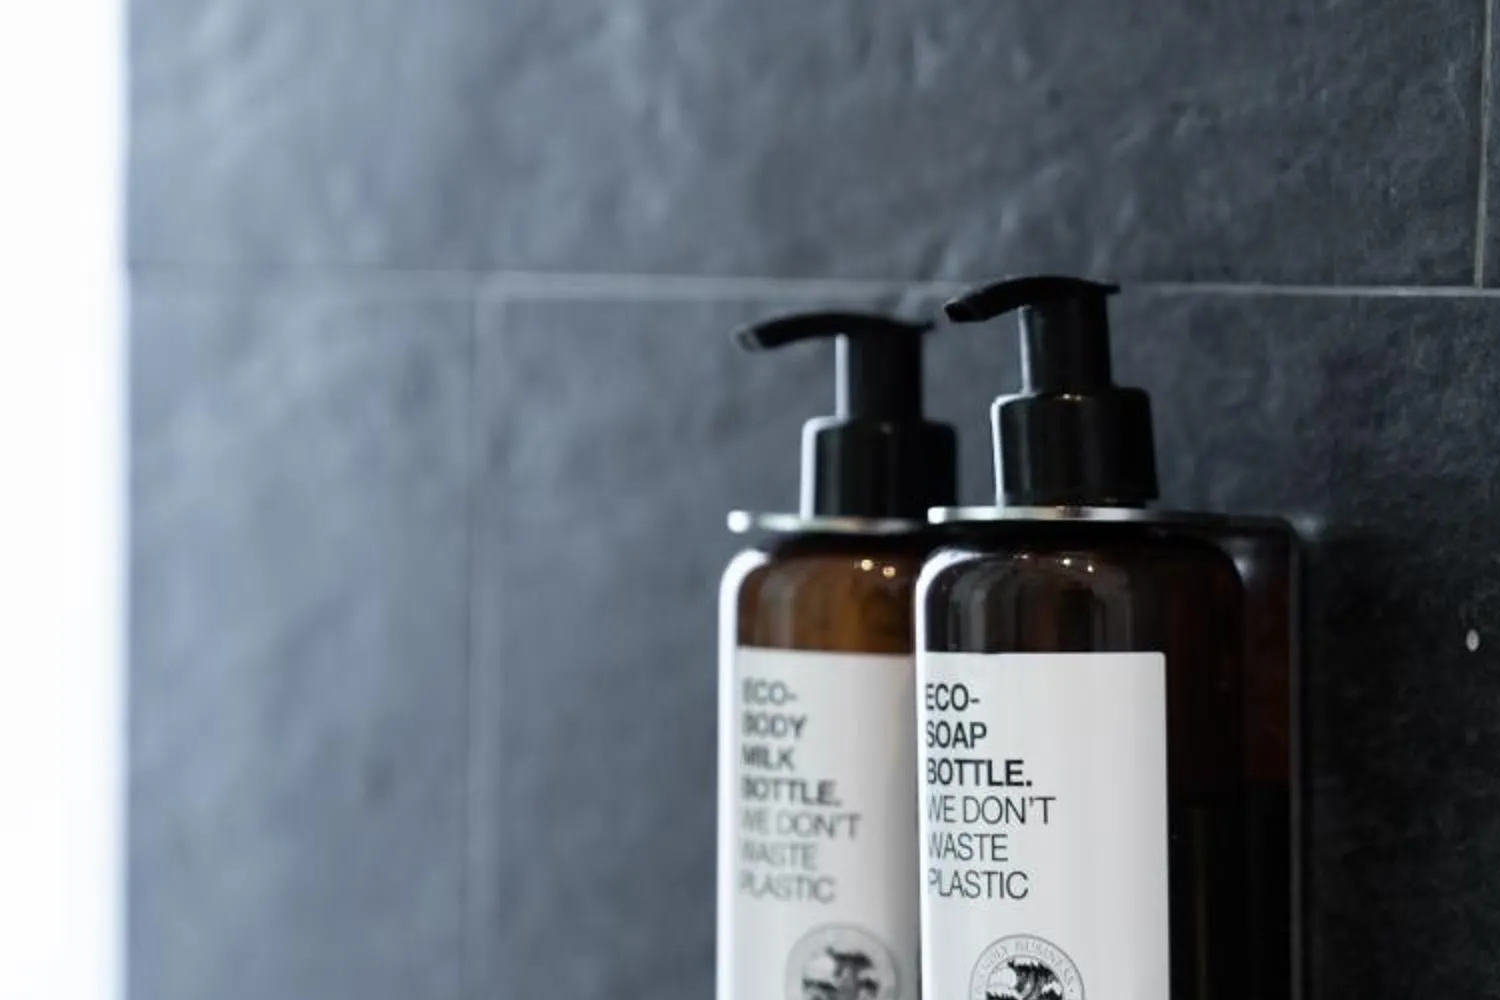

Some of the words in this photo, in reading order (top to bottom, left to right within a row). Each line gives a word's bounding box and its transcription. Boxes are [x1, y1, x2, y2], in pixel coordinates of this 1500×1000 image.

[926, 683, 981, 711] ECO-
[741, 708, 808, 739] BODY
[926, 720, 988, 749] SOAP
[926, 758, 1033, 787] BOTTLE.
[961, 795, 1057, 825] DON'T
[928, 867, 1029, 900] PLASTIC
